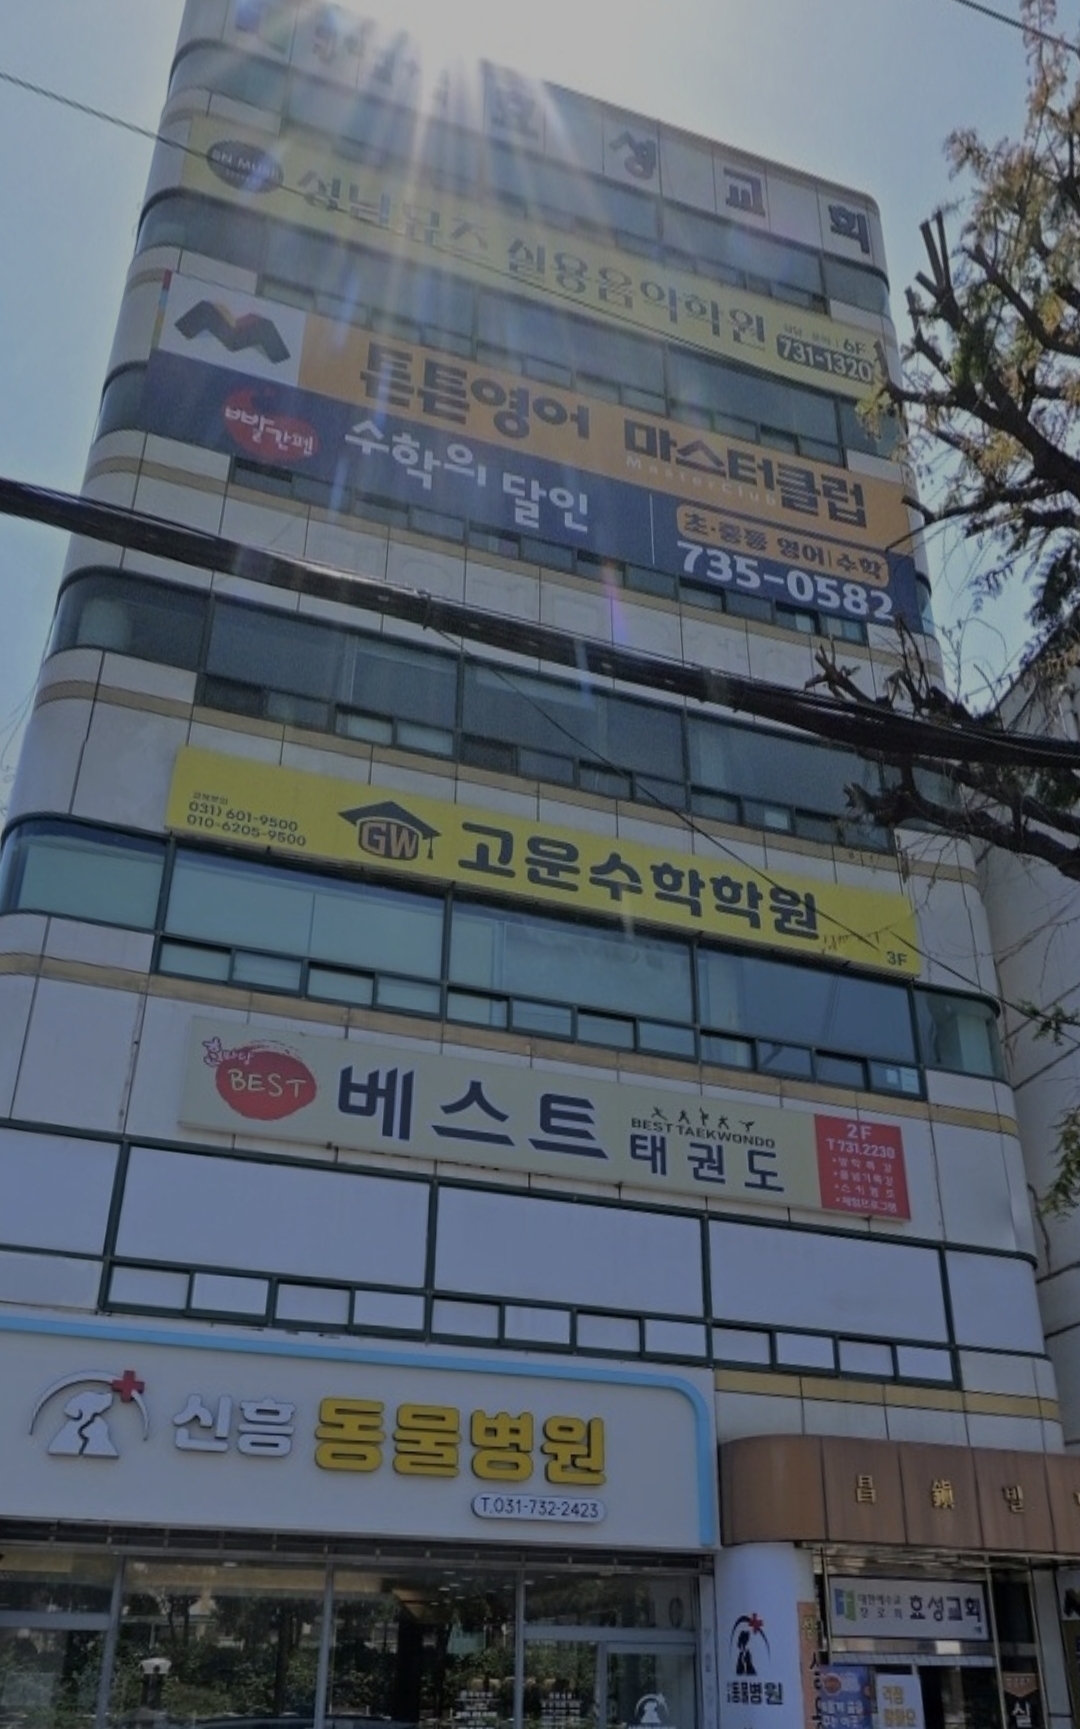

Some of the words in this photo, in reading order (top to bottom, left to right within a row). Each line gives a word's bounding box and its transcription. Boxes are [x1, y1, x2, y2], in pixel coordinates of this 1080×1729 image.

[781, 338, 873, 383] 731-1320
[360, 342, 590, 440] 튼튼영어
[624, 418, 867, 529] 마스터클럽
[224, 405, 315, 458] 빨간펜
[345, 419, 487, 491] 수학의
[503, 471, 588, 533] 달인
[677, 540, 894, 621] 735-0582
[186, 813, 307, 847] 010-6205-9500
[226, 808, 299, 832] 601-9500
[361, 821, 418, 860] GW
[458, 821, 819, 941] 고운수학학원
[886, 950, 908, 967] 3F
[228, 1067, 307, 1099] BEST
[338, 1065, 609, 1160] 베스트
[846, 1123, 873, 1140] 2F
[630, 1134, 785, 1193] 태권도
[172, 1394, 297, 1457] 신흥
[315, 1396, 608, 1485] 동물병원
[481, 1496, 599, 1520] T.031-732-2423
[909, 1595, 982, 1623] 효성교회
